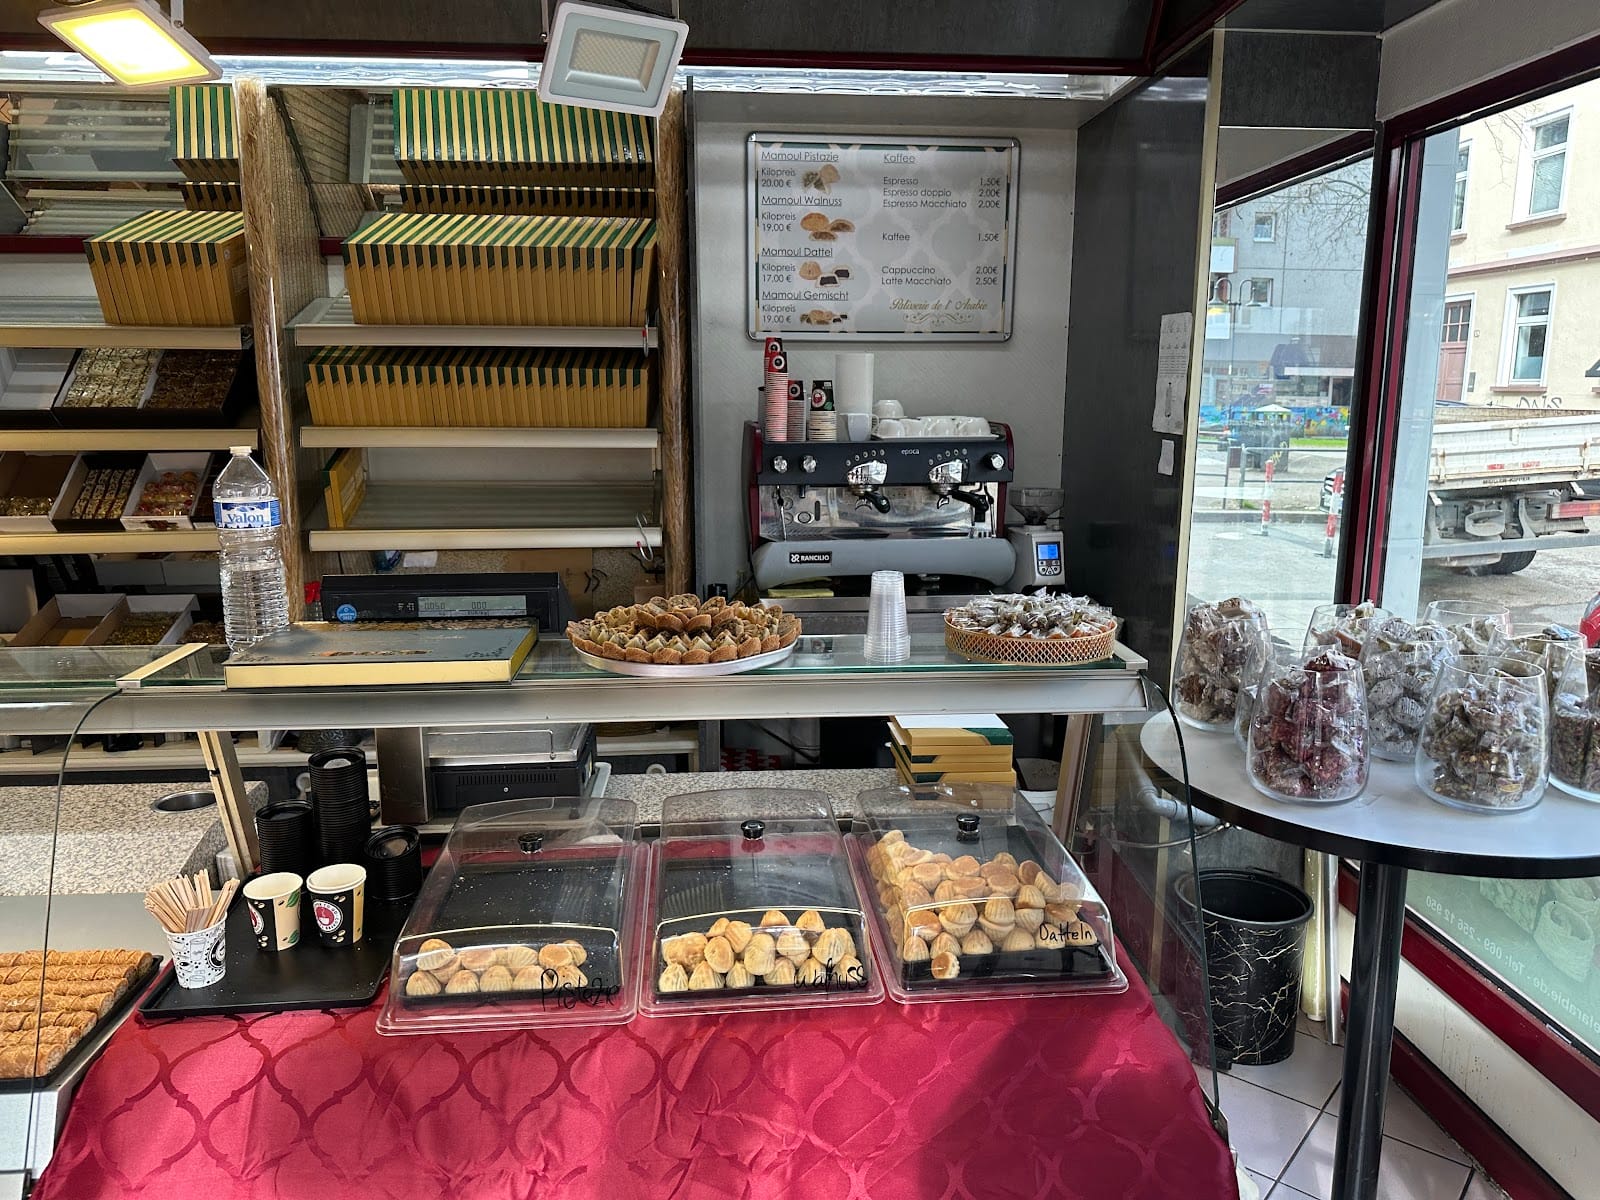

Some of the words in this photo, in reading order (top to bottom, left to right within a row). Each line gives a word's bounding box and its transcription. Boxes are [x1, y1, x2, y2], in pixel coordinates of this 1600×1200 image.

[761, 151, 802, 162] Mamoul
[804, 151, 839, 162] Pistazie
[883, 153, 916, 164] Kaffee
[761, 167, 796, 178] Kilopreis
[786, 179, 792, 188] €
[883, 176, 919, 187] Espresso
[883, 187, 919, 198] Espresso
[920, 188, 952, 198] doppio
[761, 195, 802, 206] Mamoul
[804, 196, 843, 207] Walnuss
[883, 199, 918, 210] Espresso
[920, 199, 968, 209] Macchiato
[761, 211, 797, 222] Kilopreis
[786, 223, 792, 232] €
[882, 232, 911, 242] Kaffee
[761, 247, 802, 258] Mamoul
[804, 247, 833, 258] Dattel
[761, 263, 796, 274] Kilopreis
[881, 265, 936, 276] Cappuccino
[786, 275, 792, 283] €
[881, 276, 904, 286] Latte
[906, 277, 952, 286] Macchiato
[762, 290, 802, 301] Mamoul
[803, 290, 849, 301] Gemischt
[762, 304, 796, 315] Kilopreis
[786, 315, 792, 324] €
[1039, 921, 1093, 942] Datteln
